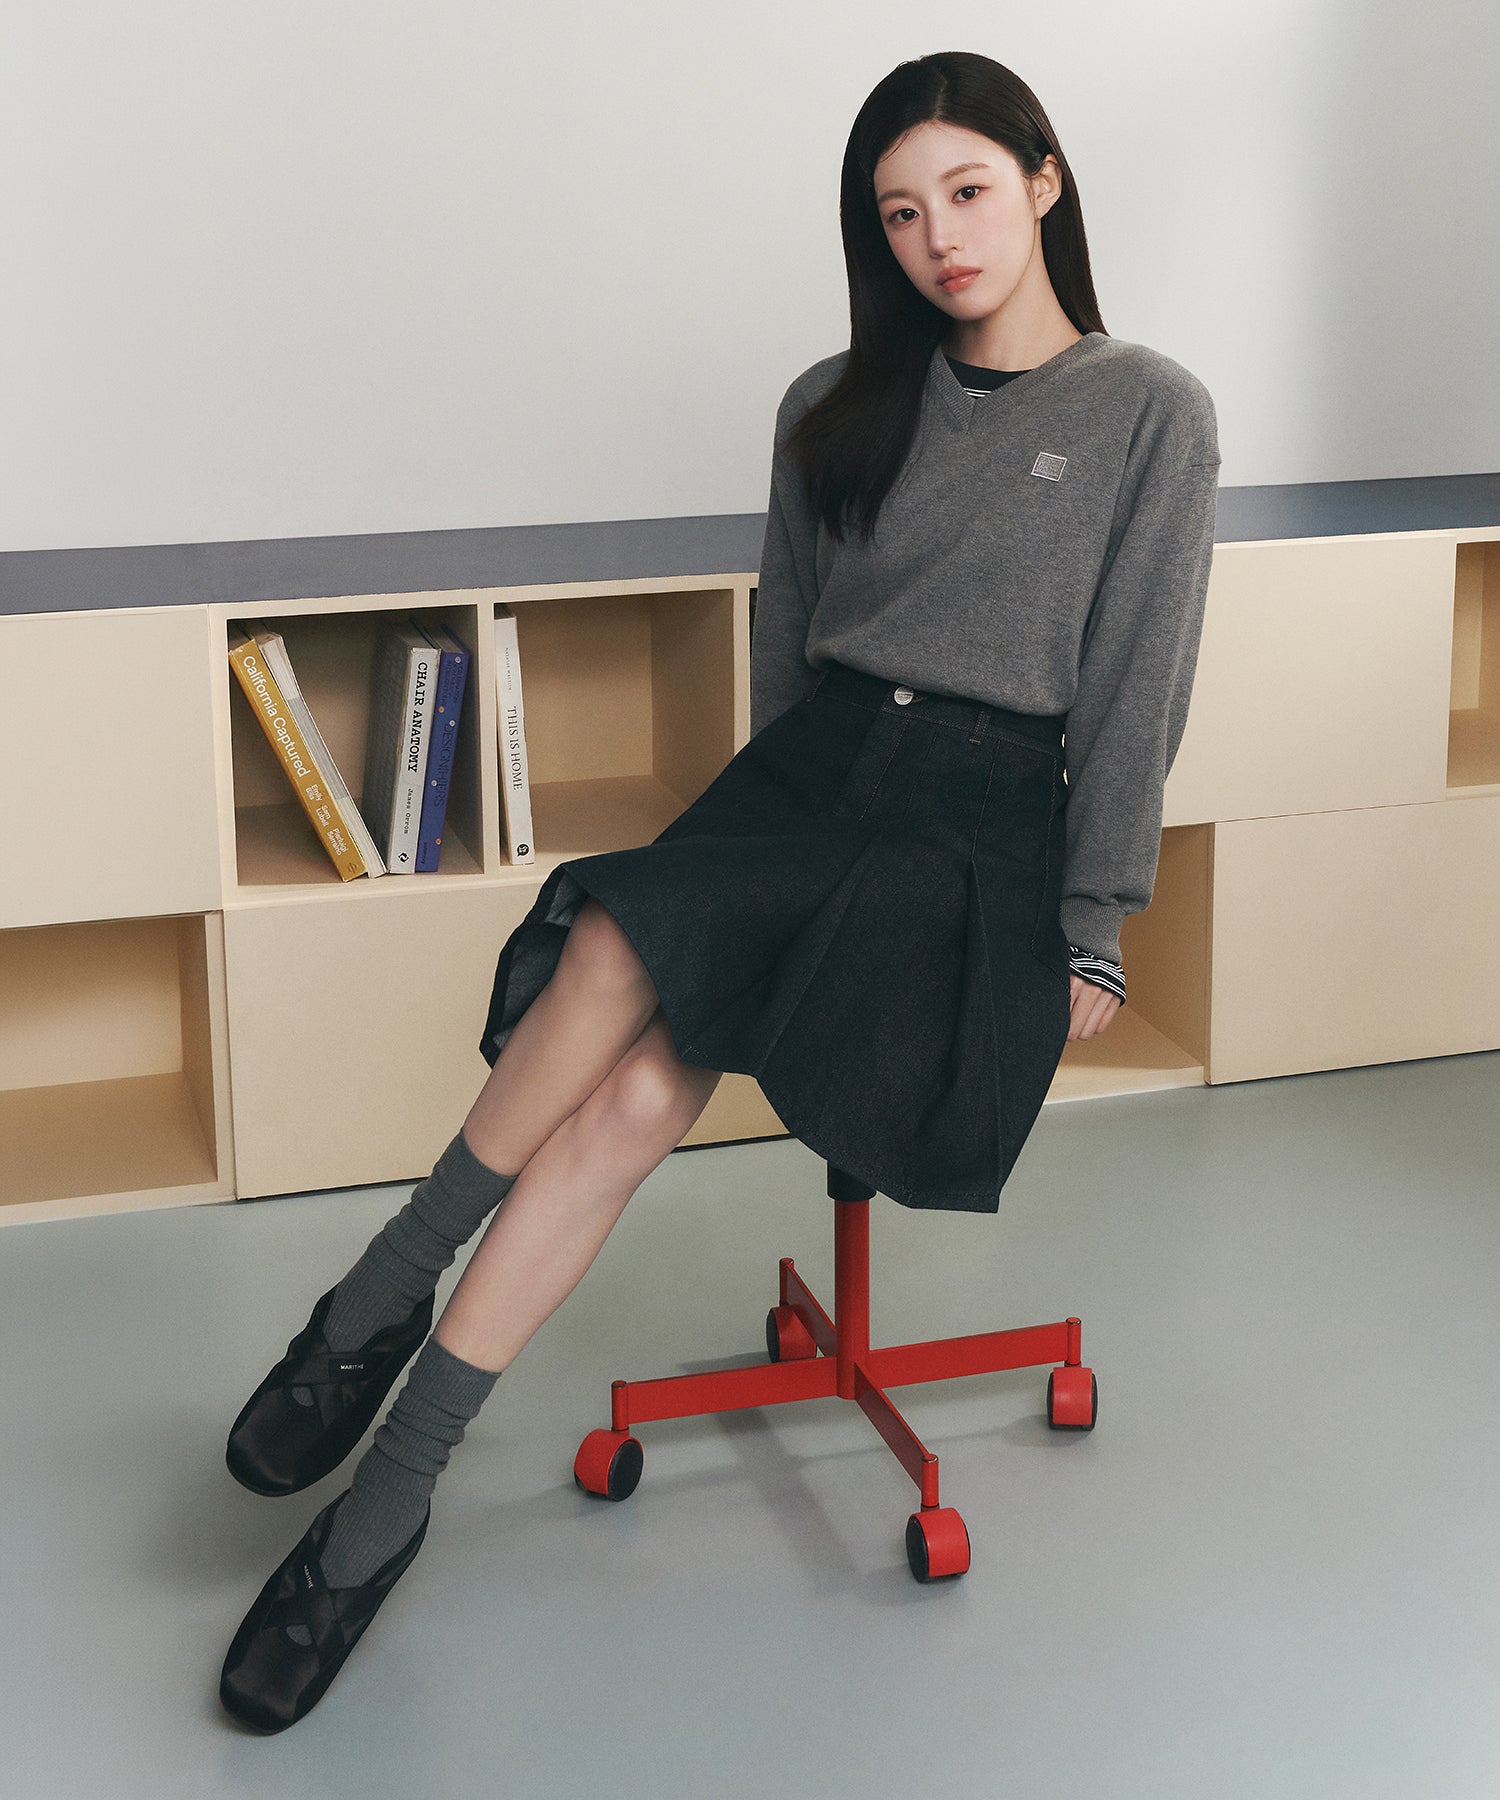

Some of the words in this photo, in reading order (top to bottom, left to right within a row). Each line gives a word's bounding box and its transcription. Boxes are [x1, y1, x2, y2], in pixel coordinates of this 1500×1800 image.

[414, 662, 428, 706] CHAIR
[243, 655, 277, 717] California
[273, 716, 311, 777] Captured
[507, 706, 518, 735] THIS
[408, 710, 423, 773] ANATOMY
[510, 738, 520, 750] IS
[511, 753, 523, 791] HOME
